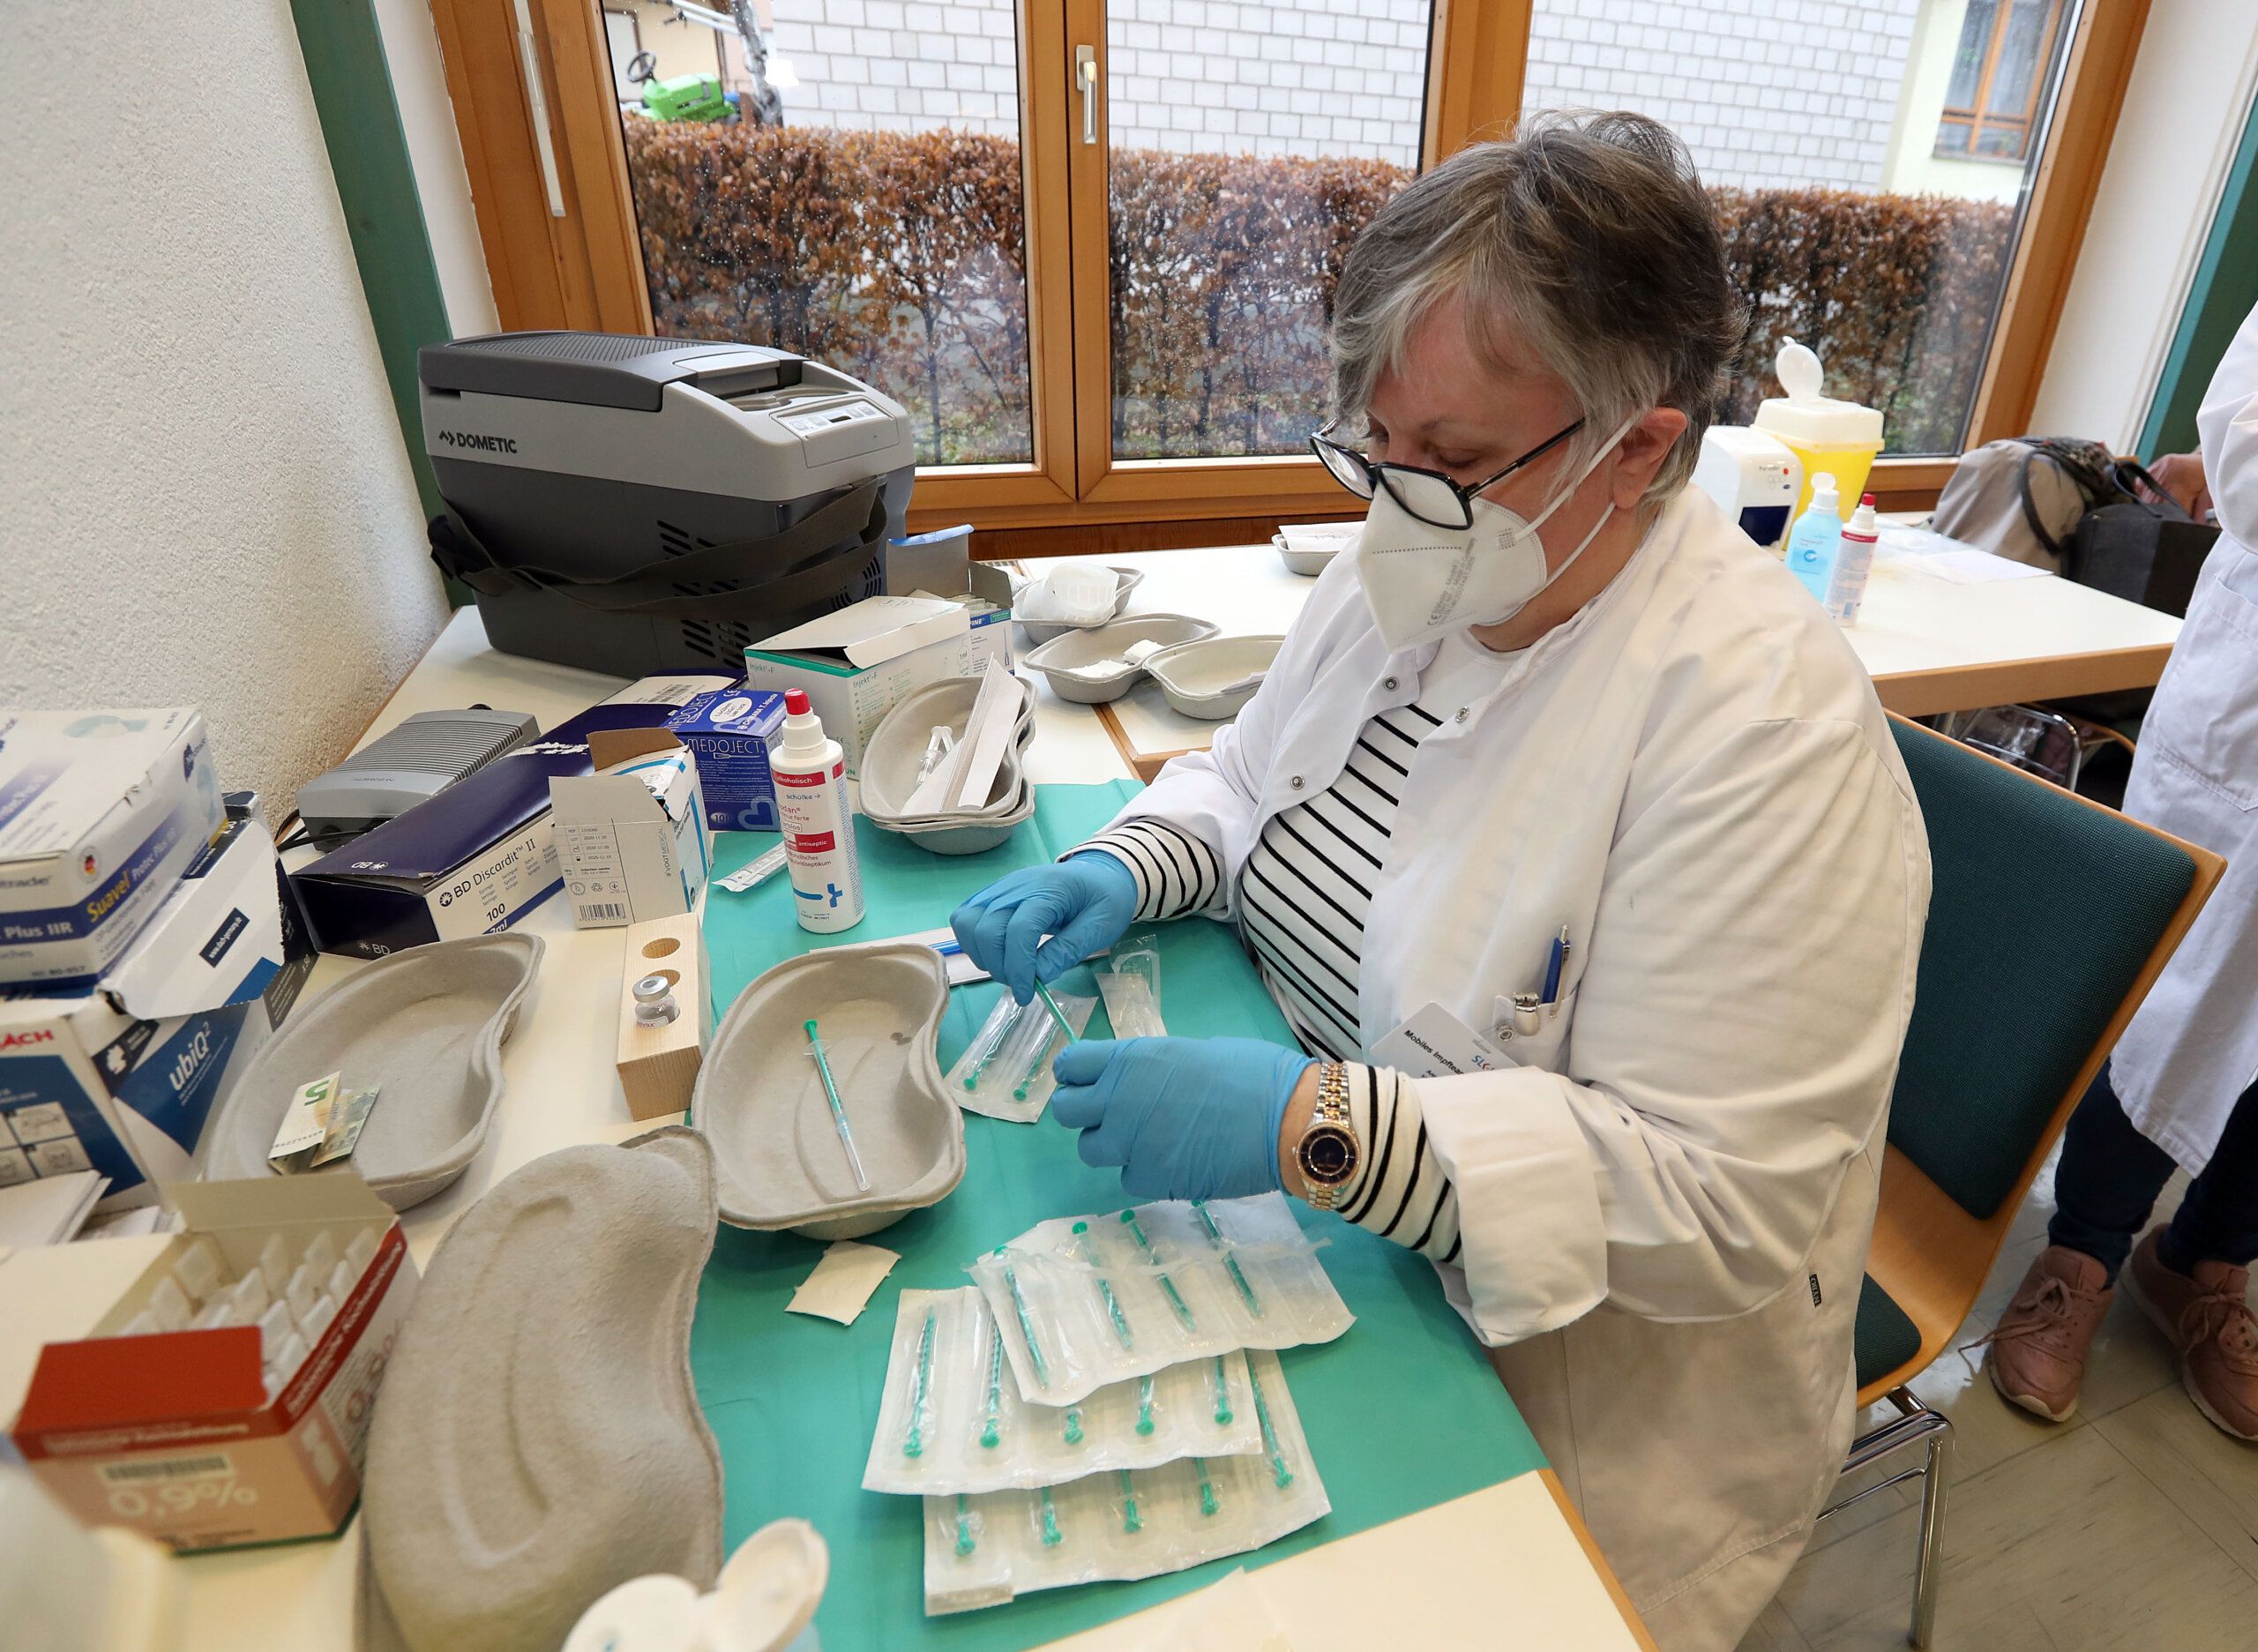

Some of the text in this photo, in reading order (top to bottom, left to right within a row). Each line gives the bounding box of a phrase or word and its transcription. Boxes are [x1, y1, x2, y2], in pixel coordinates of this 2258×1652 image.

[456, 432, 518, 454] DOMETIC
[688, 738, 760, 754] MEDOJECT
[86, 871, 131, 923] Suavel
[453, 880, 472, 898] BD
[486, 902, 505, 922] 100
[4, 921, 74, 939] Plus IIR
[371, 944, 391, 955] BD
[0, 1029, 55, 1051] ACH
[1404, 1029, 1433, 1054] Mobiles
[303, 1080, 330, 1107] 5
